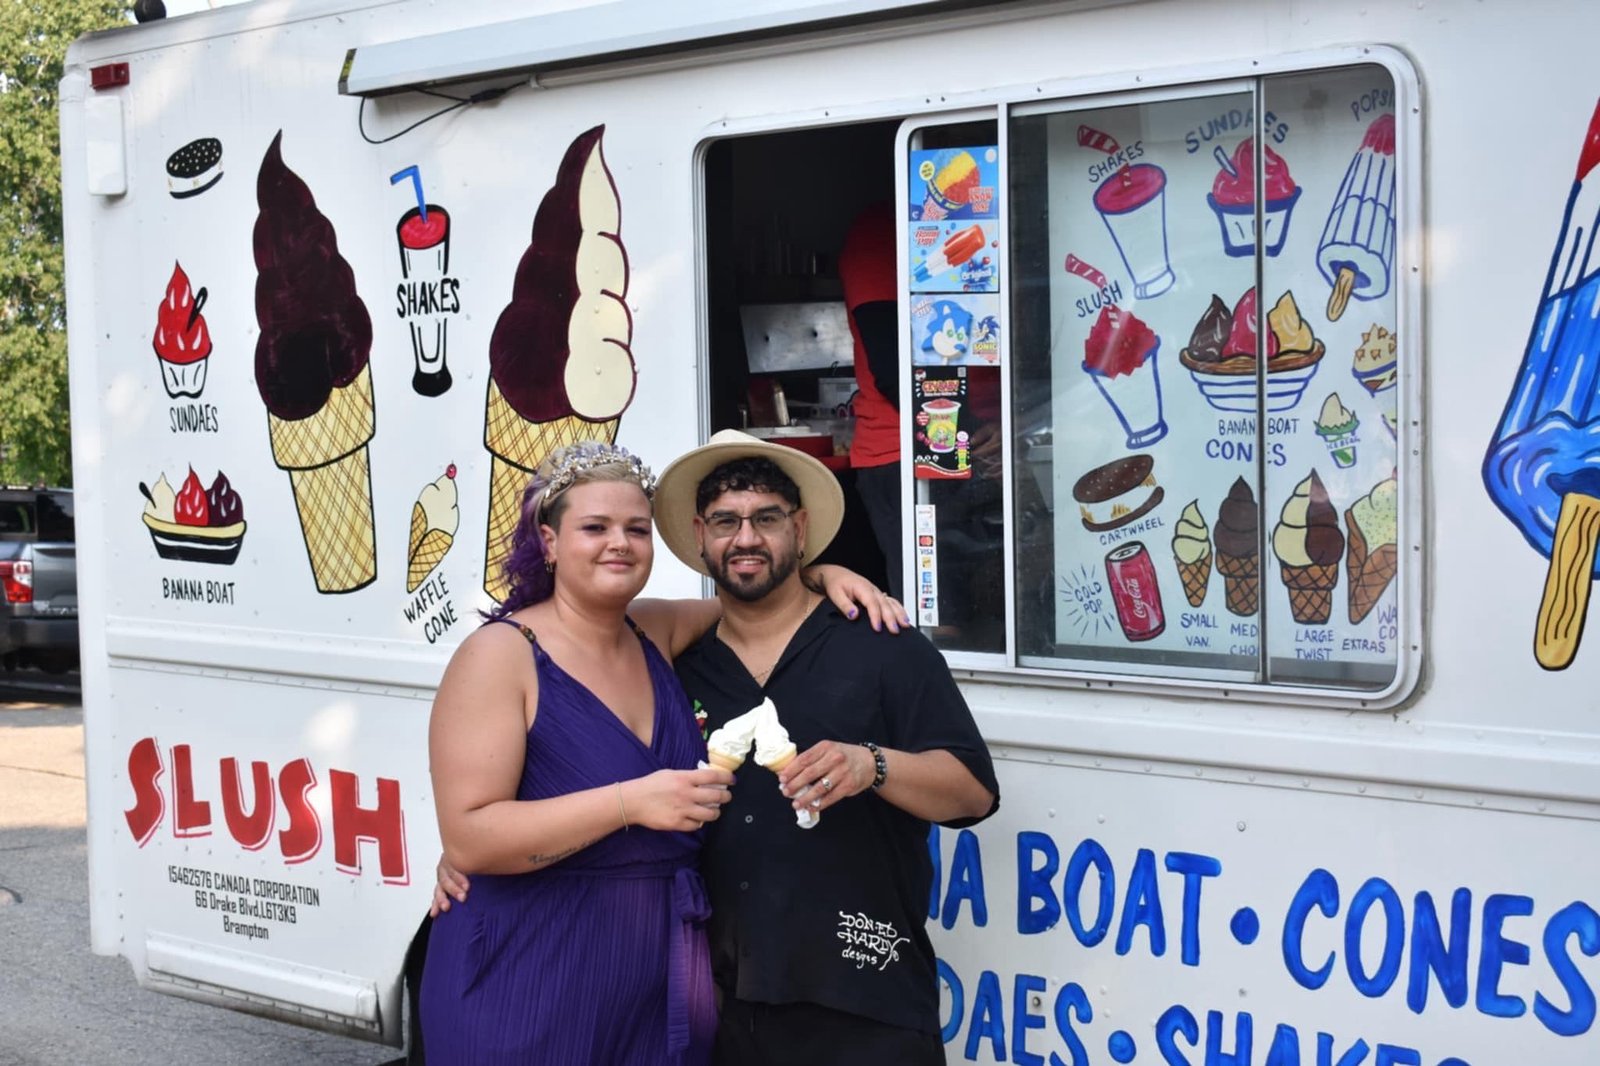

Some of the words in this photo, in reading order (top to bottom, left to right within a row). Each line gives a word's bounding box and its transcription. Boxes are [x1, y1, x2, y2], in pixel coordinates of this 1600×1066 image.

[1088, 140, 1144, 183] SHAKES
[396, 278, 460, 319] SHAKES
[1076, 280, 1123, 318] SLUSH
[169, 403, 219, 433] SUNDAES
[1218, 418, 1257, 436] BANAN
[1267, 418, 1299, 435] BOAT
[1205, 439, 1287, 467] CONS
[1099, 517, 1165, 545] CARTWHEEL
[162, 577, 204, 602] BANANA
[206, 580, 235, 606] BOAT
[403, 572, 449, 624] WAFFLE
[1074, 582, 1102, 602] COLD
[1083, 599, 1103, 615] POP
[1180, 613, 1219, 628] SMALL
[424, 600, 458, 644] CONE
[1295, 629, 1334, 643] LARGE
[1230, 644, 1259, 656] CHO
[1295, 648, 1333, 660] TWIST
[1342, 639, 1386, 653] EXTRAS
[124, 736, 410, 886] SLUSH
[168, 865, 212, 888] 15462576
[214, 872, 251, 895] CANADA
[253, 879, 320, 906] CORPORATION
[195, 890, 208, 908] 66
[210, 892, 237, 914] Drake
[223, 915, 269, 940] Brampton
[1018, 831, 1224, 968] BOAT
[1282, 867, 1600, 1037] CONES
